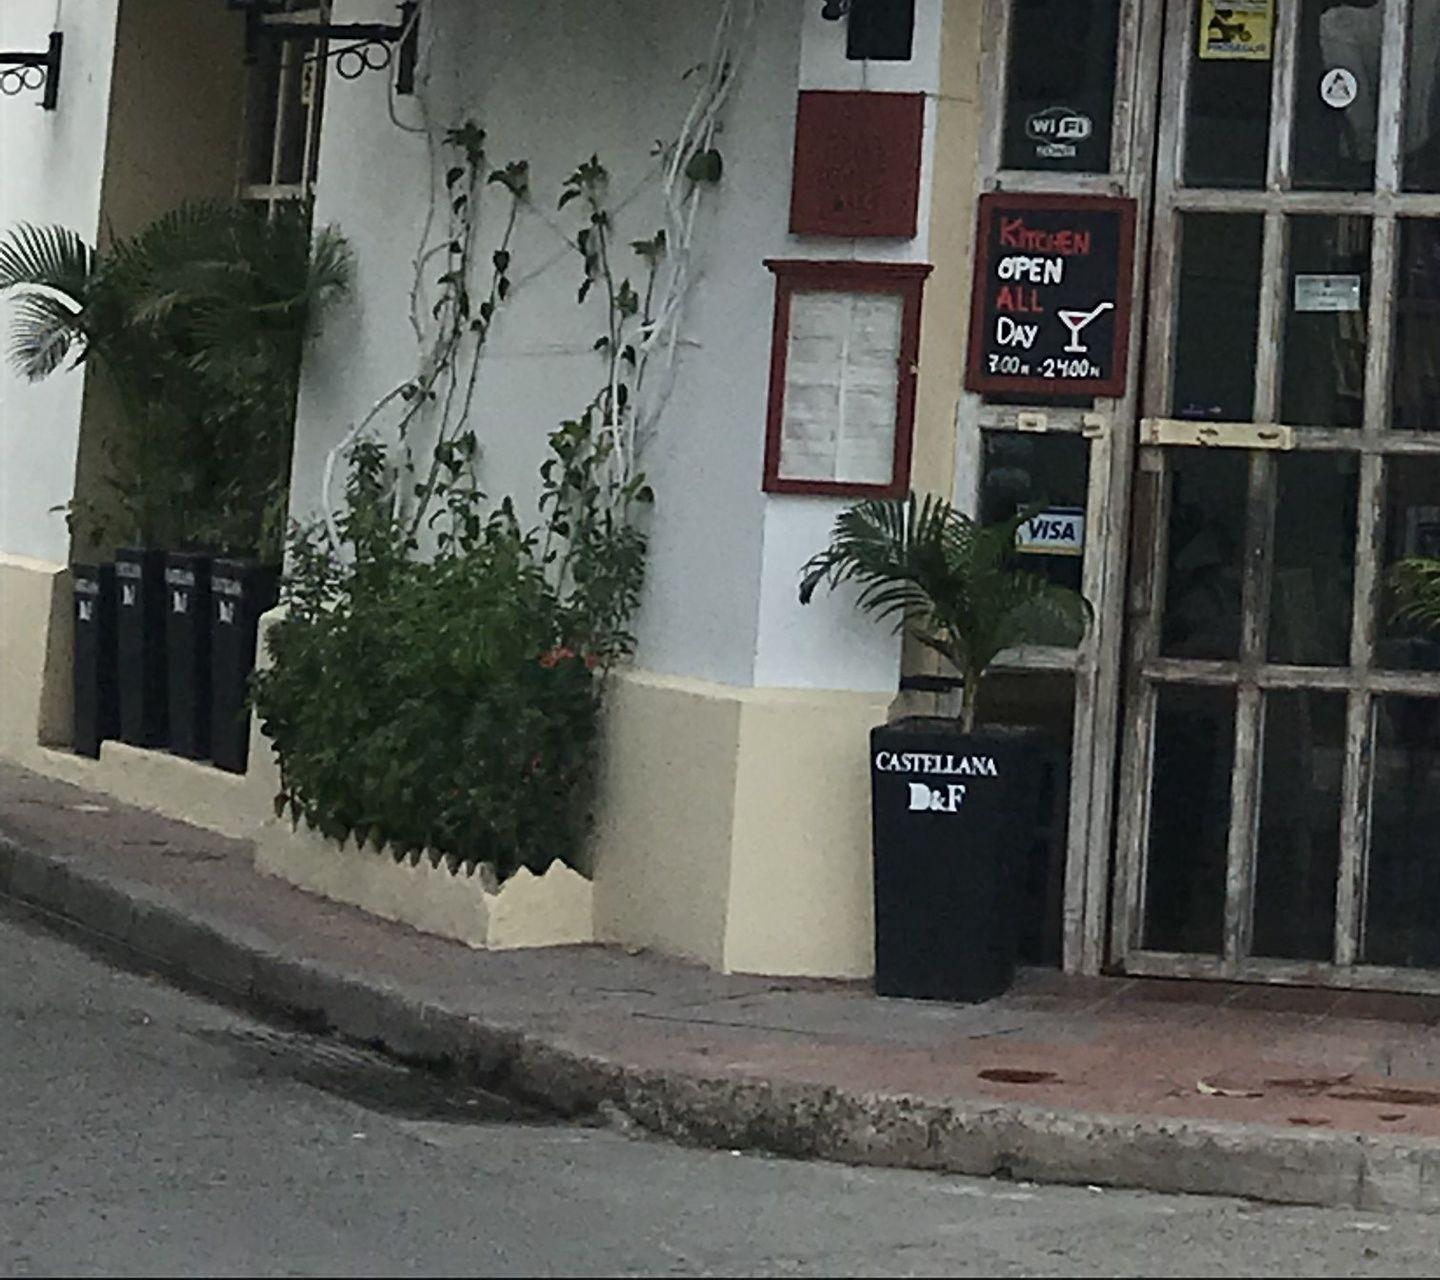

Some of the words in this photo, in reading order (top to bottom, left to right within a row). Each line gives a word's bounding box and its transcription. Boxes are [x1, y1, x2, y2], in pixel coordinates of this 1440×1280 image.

[998, 256, 1064, 284] OPEN
[996, 287, 1043, 311] ALL
[1029, 519, 1076, 541] VISA
[876, 751, 998, 776] CASTELLANA
